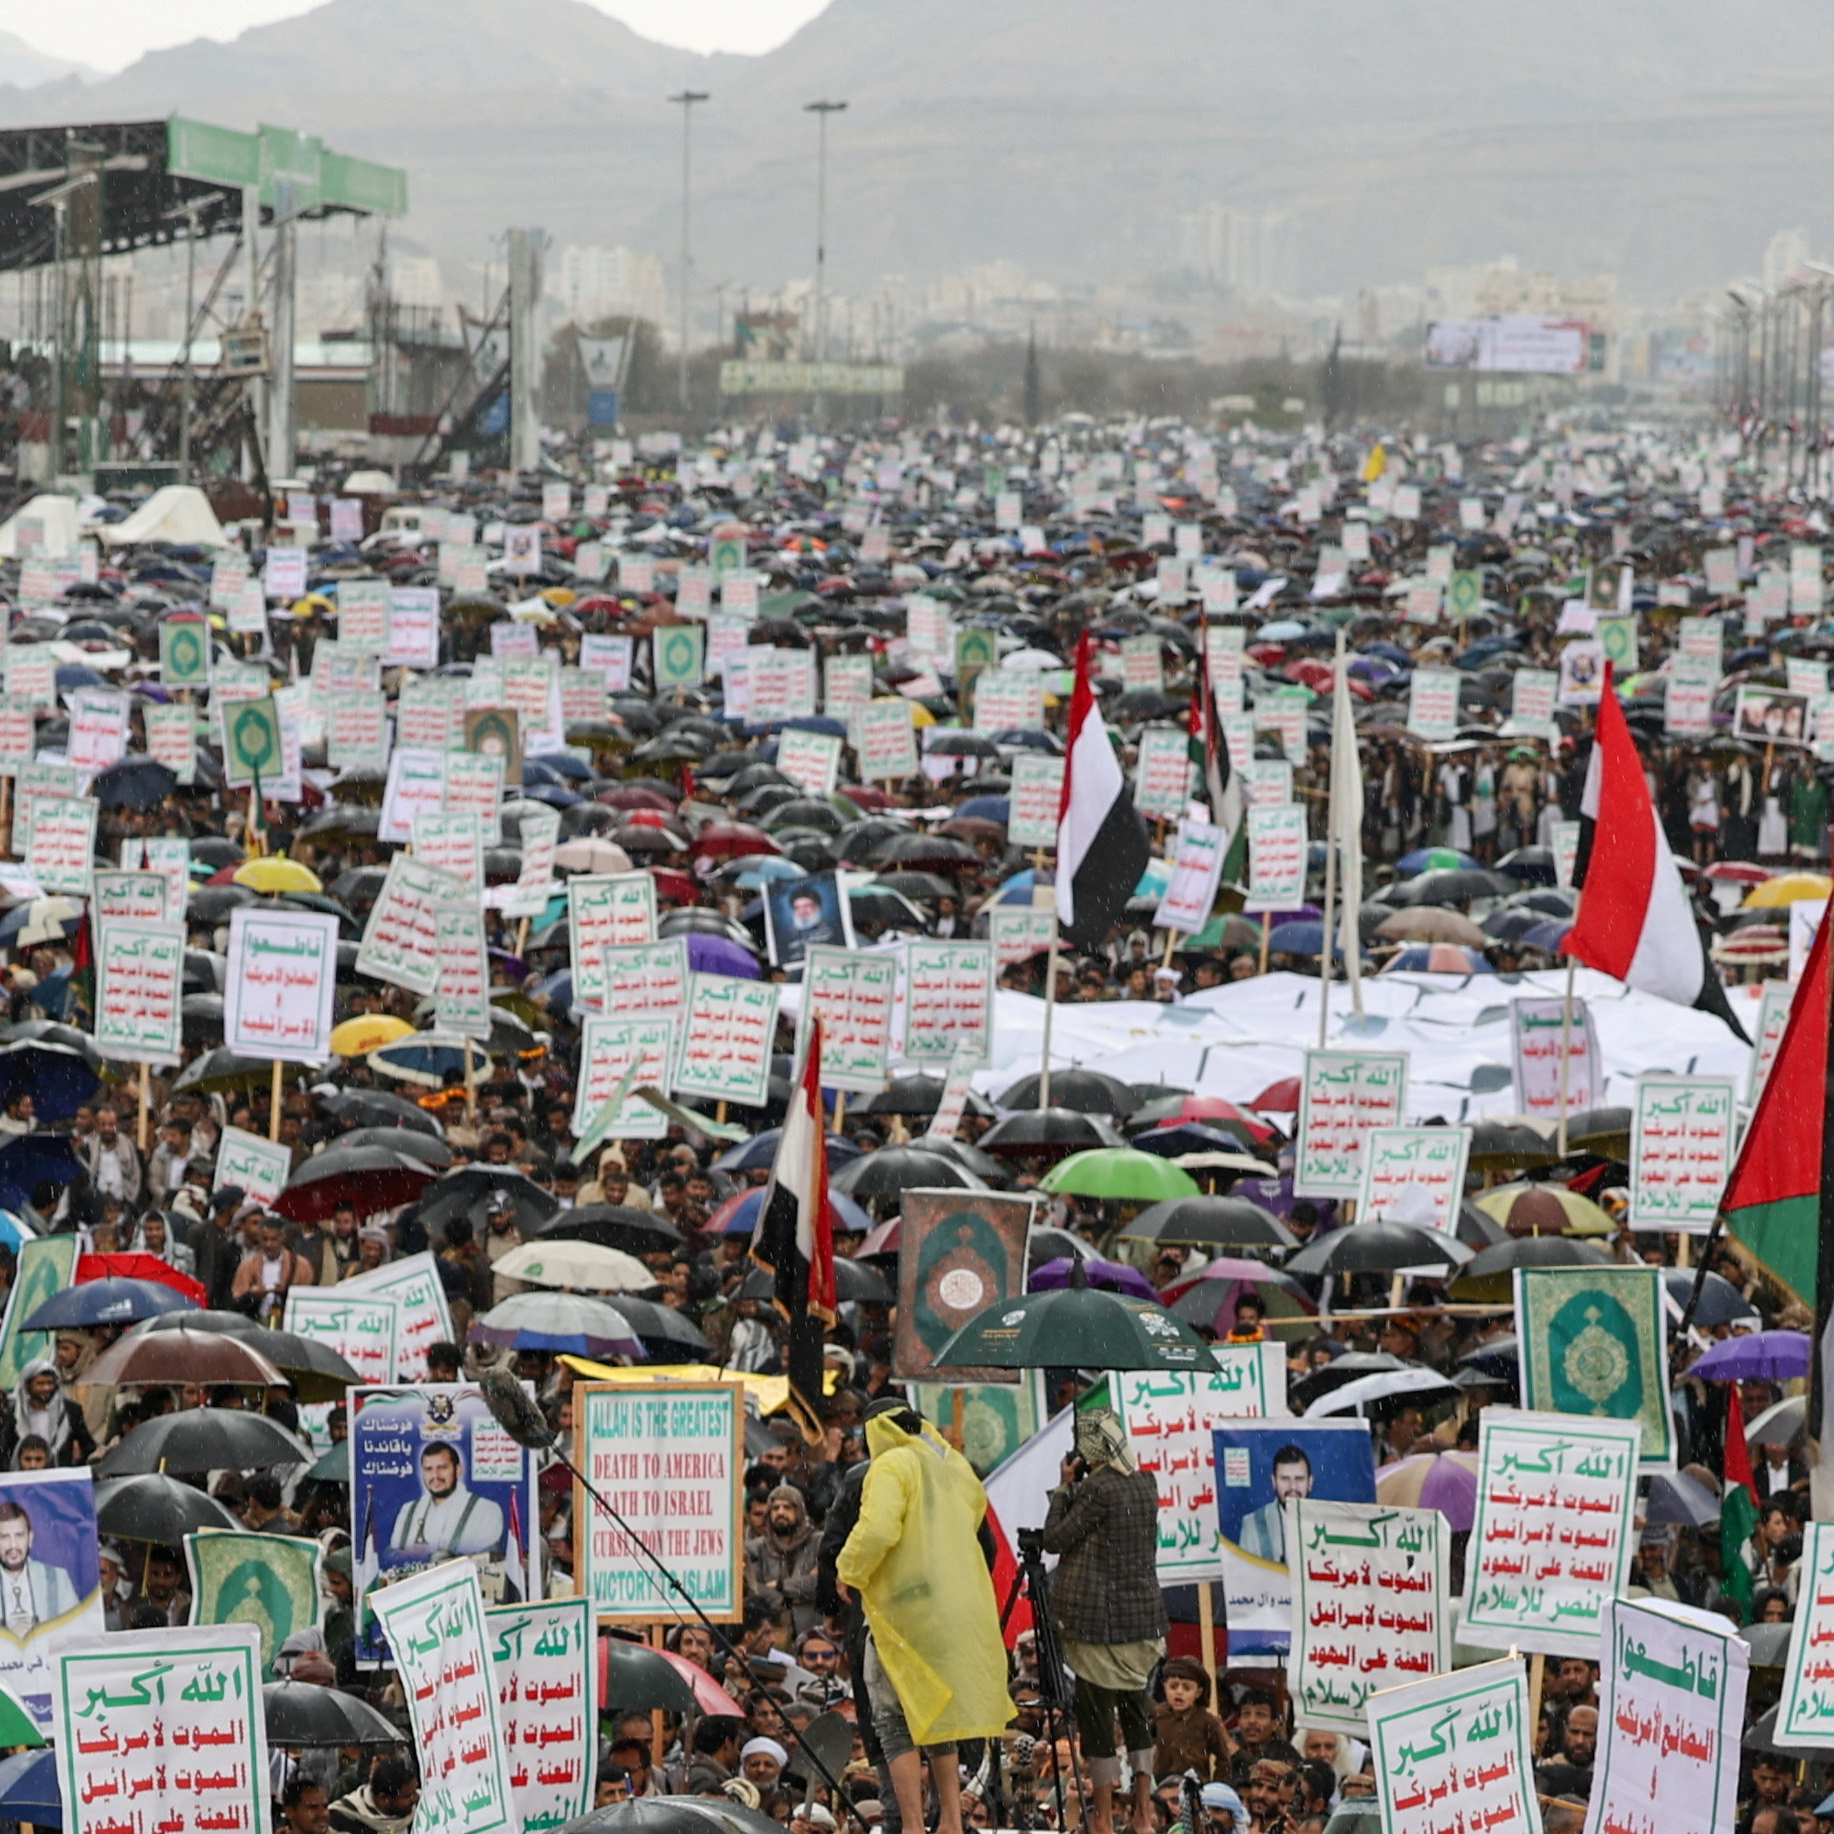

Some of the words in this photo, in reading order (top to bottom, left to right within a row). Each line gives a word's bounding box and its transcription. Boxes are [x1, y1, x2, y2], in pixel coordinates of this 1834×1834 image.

[362, 1417, 413, 1432] فوضناك
[592, 1402, 628, 1438] ALLAH
[632, 1402, 642, 1437] IS
[647, 1402, 667, 1437] THE
[672, 1401, 729, 1437] GREATEST
[362, 1462, 414, 1478] فوضناك
[594, 1454, 638, 1479] DEATH
[643, 1453, 660, 1479] TO
[664, 1453, 725, 1478] AMERICA
[595, 1491, 638, 1516] DEATH
[643, 1491, 660, 1516] TO
[664, 1490, 713, 1515] ISRAEL
[593, 1530, 630, 1557] CURSE
[667, 1530, 690, 1556] THE
[693, 1529, 724, 1556] JEWS
[594, 1570, 654, 1600] VICTORY
[683, 1569, 726, 1600] ISLAM
